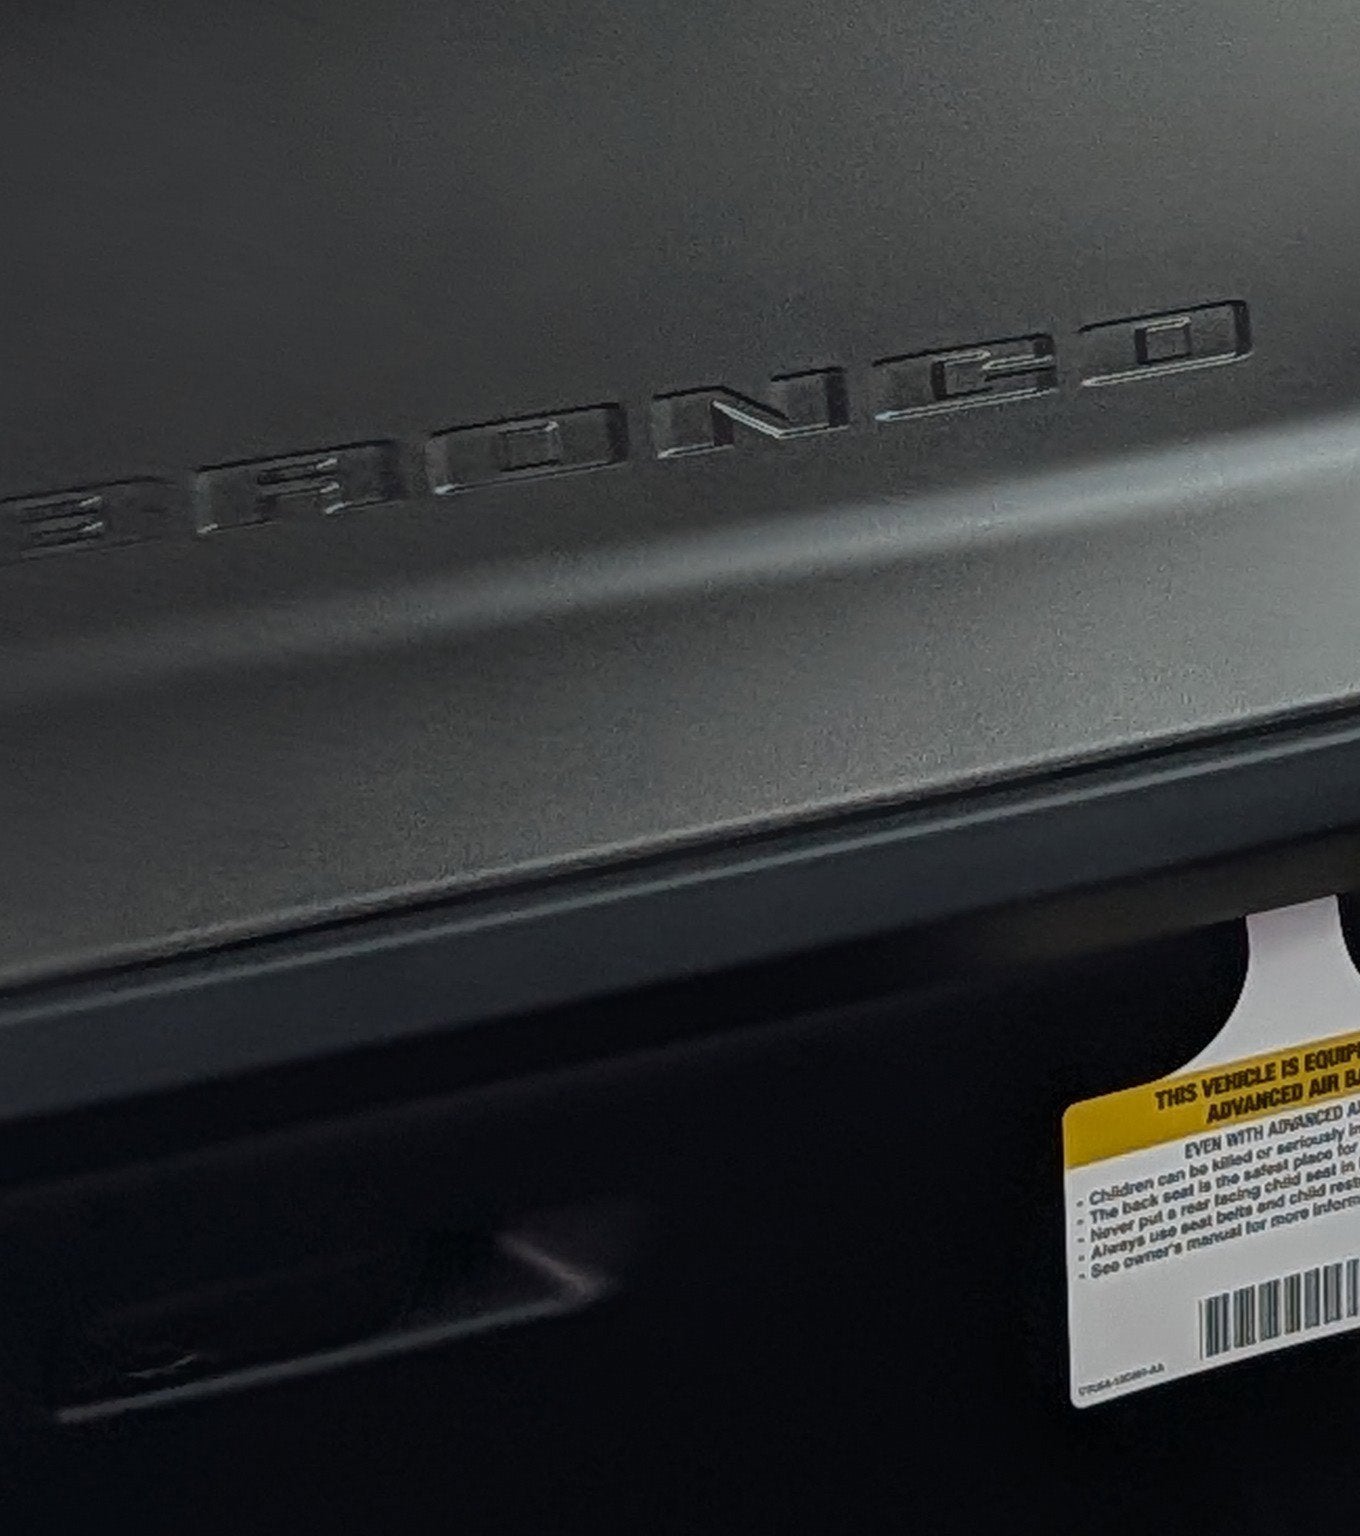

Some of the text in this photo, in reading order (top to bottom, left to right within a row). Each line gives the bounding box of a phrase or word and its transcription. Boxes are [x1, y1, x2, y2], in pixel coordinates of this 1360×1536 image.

[0, 300, 1252, 558] BRONCO
[1155, 1083, 1198, 1110] THIS
[1202, 1063, 1276, 1097] VEHICLE
[1282, 1056, 1300, 1080] IS
[1207, 1086, 1303, 1124] ADVANCED
[1309, 1072, 1339, 1098] AIR
[1089, 1176, 1154, 1206] Children
[1157, 1169, 1185, 1187] can
[1189, 1161, 1208, 1178] be
[1212, 1150, 1253, 1173] killed
[1256, 1146, 1272, 1159] or
[1277, 1123, 1345, 1156] seriously
[1185, 1135, 1222, 1159] EVEN
[1226, 1124, 1264, 1147] WITH
[1268, 1105, 1343, 1138] ADVANCED
[1089, 1206, 1119, 1224] The
[1122, 1194, 1158, 1215] back
[1163, 1183, 1194, 1203] seat
[1198, 1178, 1211, 1193] is
[1216, 1171, 1240, 1189] the
[1244, 1158, 1289, 1181] safest
[1294, 1149, 1333, 1172] place
[1338, 1141, 1358, 1157] for
[1091, 1218, 1135, 1242] Never
[1138, 1212, 1163, 1232] put
[1168, 1208, 1176, 1220] a
[1180, 1199, 1210, 1216] rear
[1214, 1185, 1261, 1208] facing
[1265, 1172, 1301, 1195] child
[1306, 1164, 1337, 1183] seat
[1341, 1159, 1355, 1174] in
[1090, 1263, 1120, 1279] See
[1124, 1243, 1182, 1269] owner's
[1187, 1224, 1242, 1251] manual
[1246, 1218, 1267, 1235] for
[1271, 1207, 1309, 1227] more
[1091, 1235, 1146, 1261] Always
[1150, 1227, 1177, 1243] use
[1181, 1215, 1212, 1234] seat
[1216, 1204, 1253, 1224] belts
[1257, 1194, 1285, 1213] and
[1289, 1184, 1326, 1206] child
